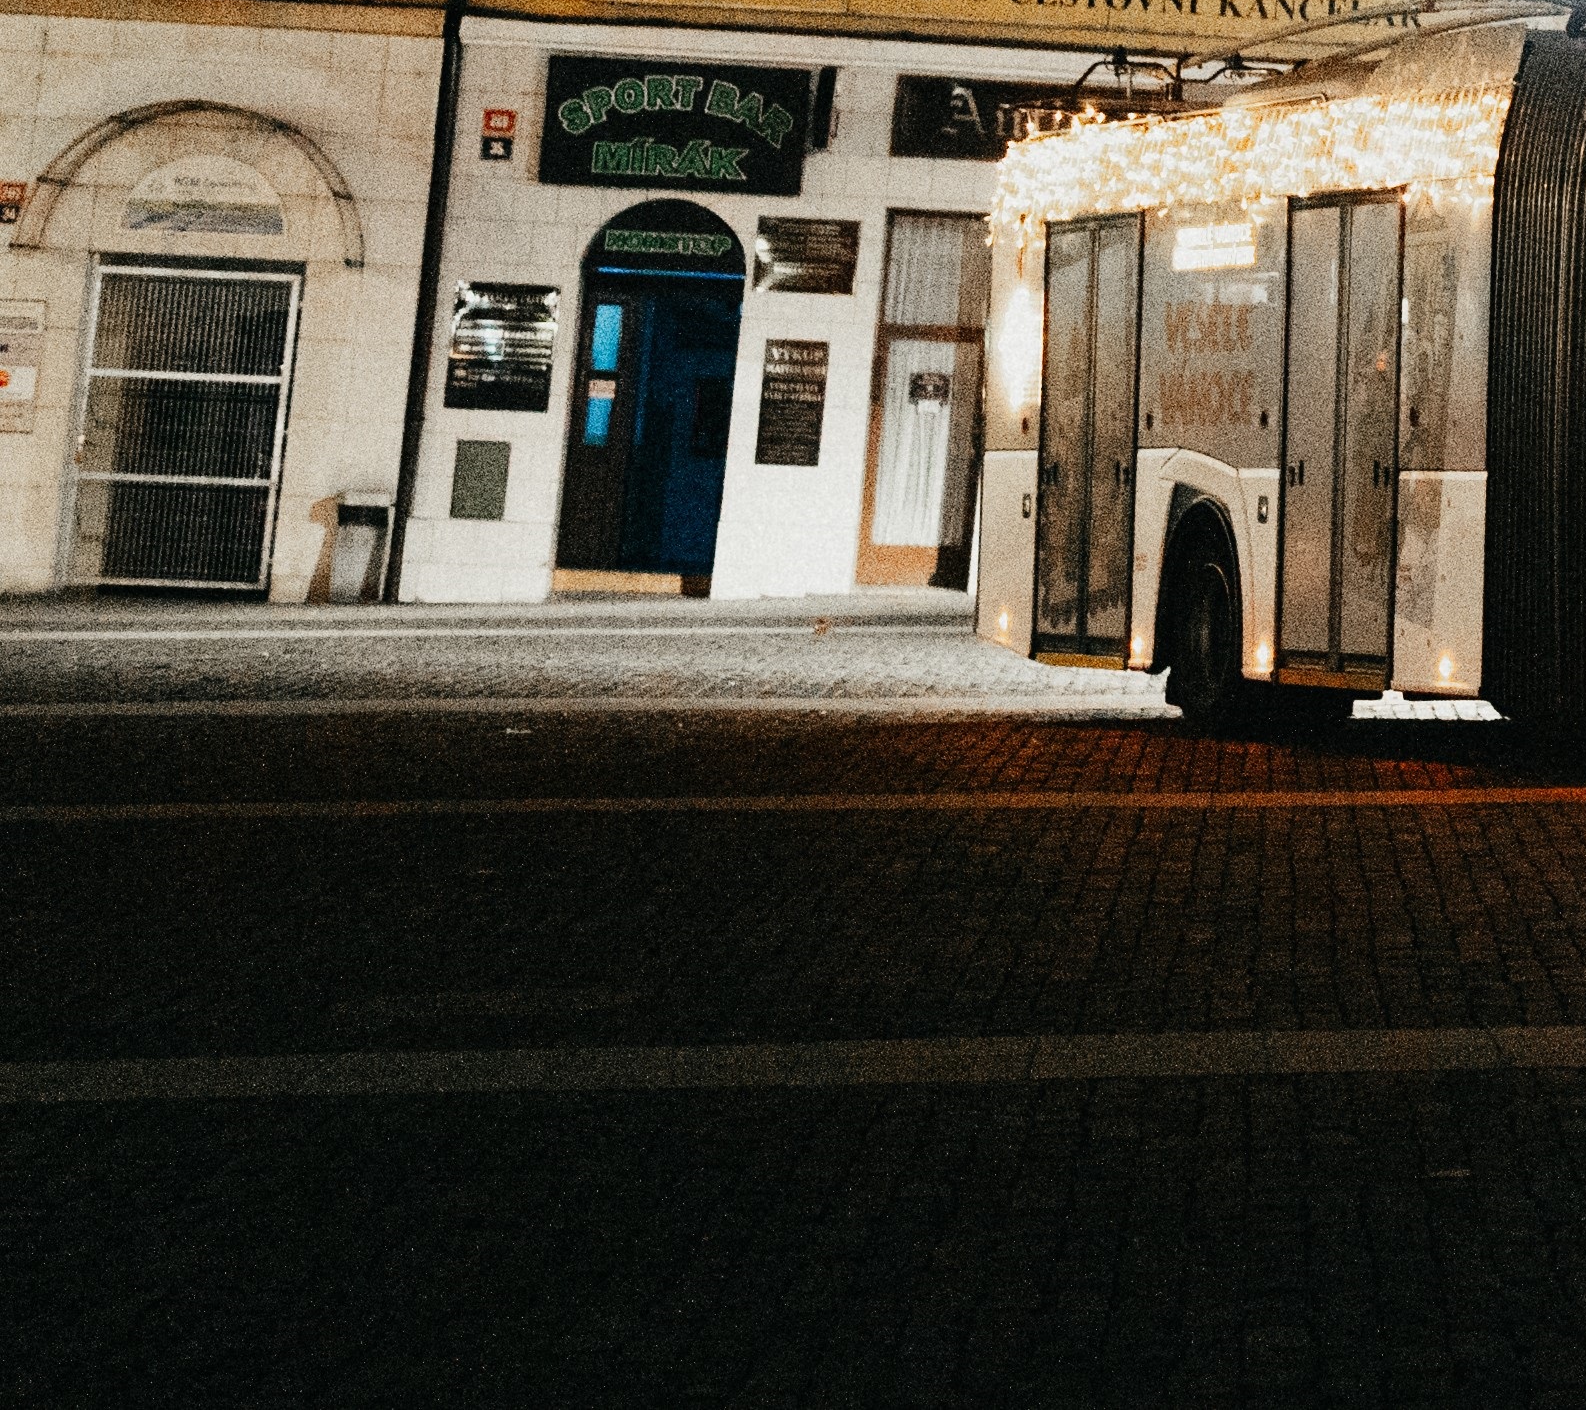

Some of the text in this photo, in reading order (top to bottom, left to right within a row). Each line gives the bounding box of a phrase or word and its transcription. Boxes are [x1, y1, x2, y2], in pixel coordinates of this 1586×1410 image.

[560, 75, 702, 135] SPORT
[705, 79, 793, 148] BAR
[591, 136, 748, 180] MÍRÁK
[605, 229, 732, 256] NONSTOP
